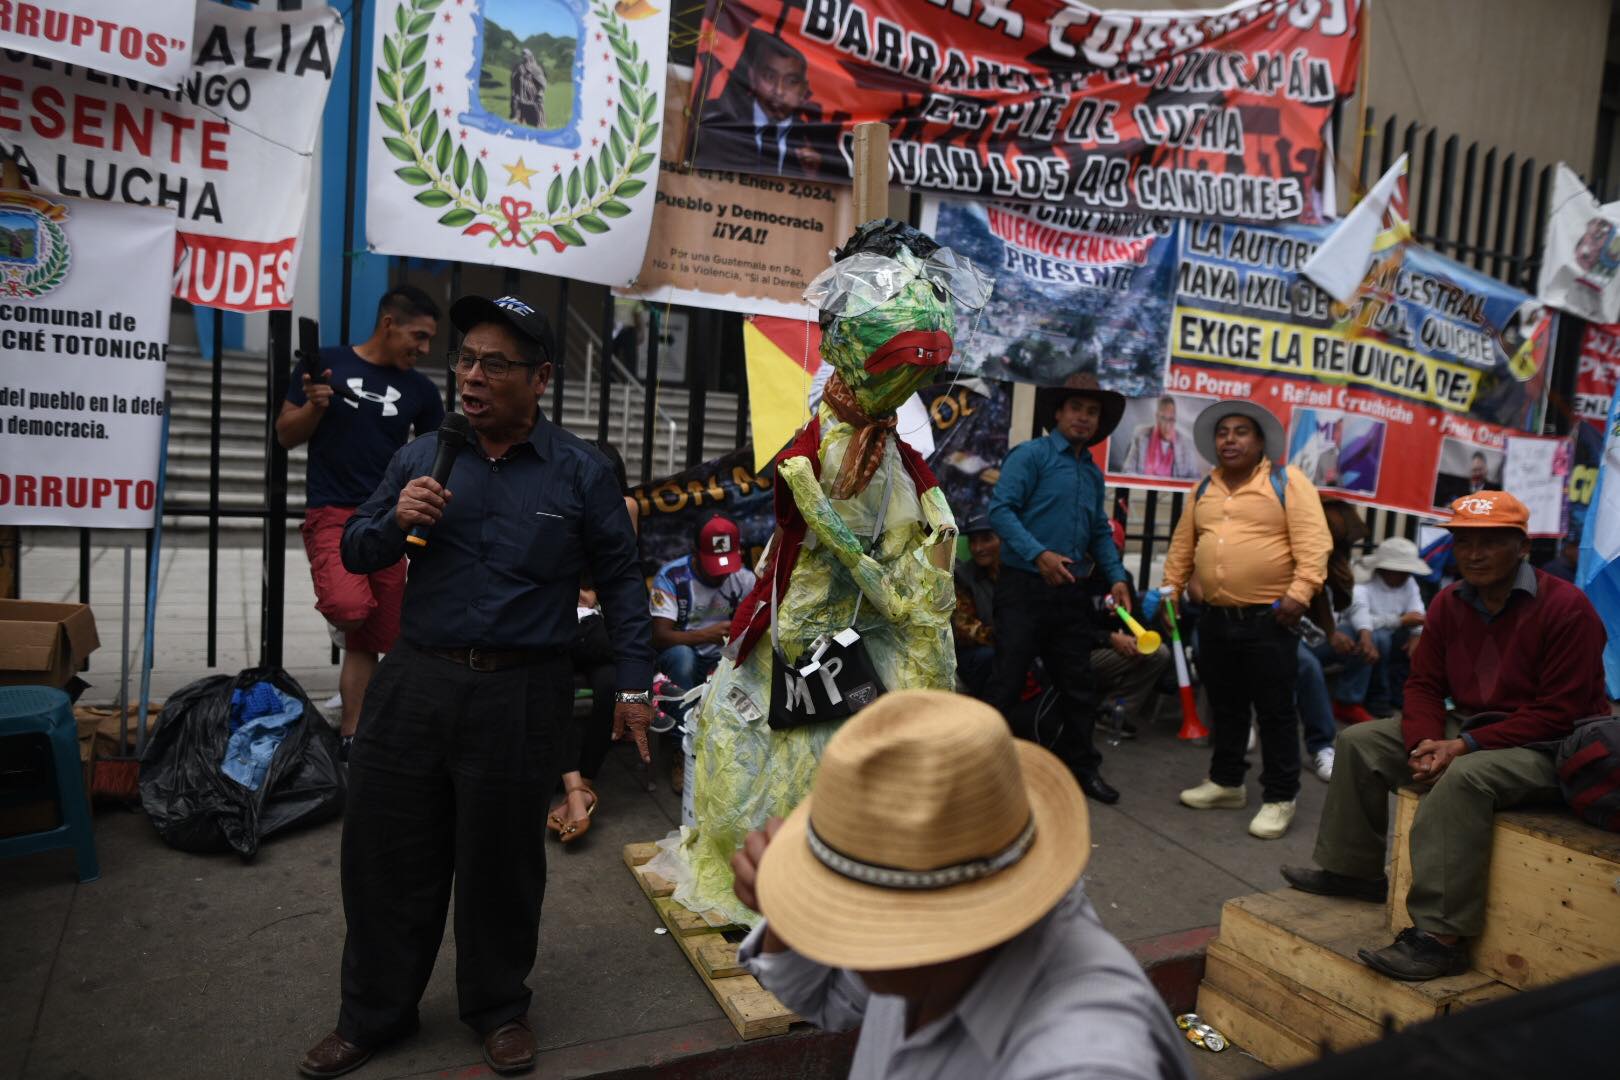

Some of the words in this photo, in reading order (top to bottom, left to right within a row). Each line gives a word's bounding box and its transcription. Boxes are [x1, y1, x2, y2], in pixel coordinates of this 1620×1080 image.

[1064, 100, 1120, 143] DE
[1133, 103, 1244, 155] LUCHA
[57, 153, 224, 225] LUCHA
[738, 175, 785, 193] Enero
[987, 152, 1070, 201] LOS
[1074, 155, 1130, 206] 48
[1134, 166, 1303, 220] CANTONES
[655, 191, 713, 213] Pueblo
[717, 204, 727, 217] y
[731, 204, 825, 232] Democracia
[1190, 219, 1222, 256] LA
[691, 250, 711, 262] una
[713, 254, 767, 272] Guatemala
[770, 264, 782, 273] en
[762, 274, 771, 284] al
[1003, 245, 1136, 292] PRESENTE
[1247, 274, 1288, 310] IXIL
[109, 312, 136, 332] de
[1180, 315, 1261, 361] EXIGE
[1271, 330, 1302, 366] LA
[29, 390, 85, 411] pueblo
[90, 395, 109, 412] en
[113, 394, 127, 414] la
[1196, 373, 1251, 396] Porras
[8, 415, 109, 440] democracia.
